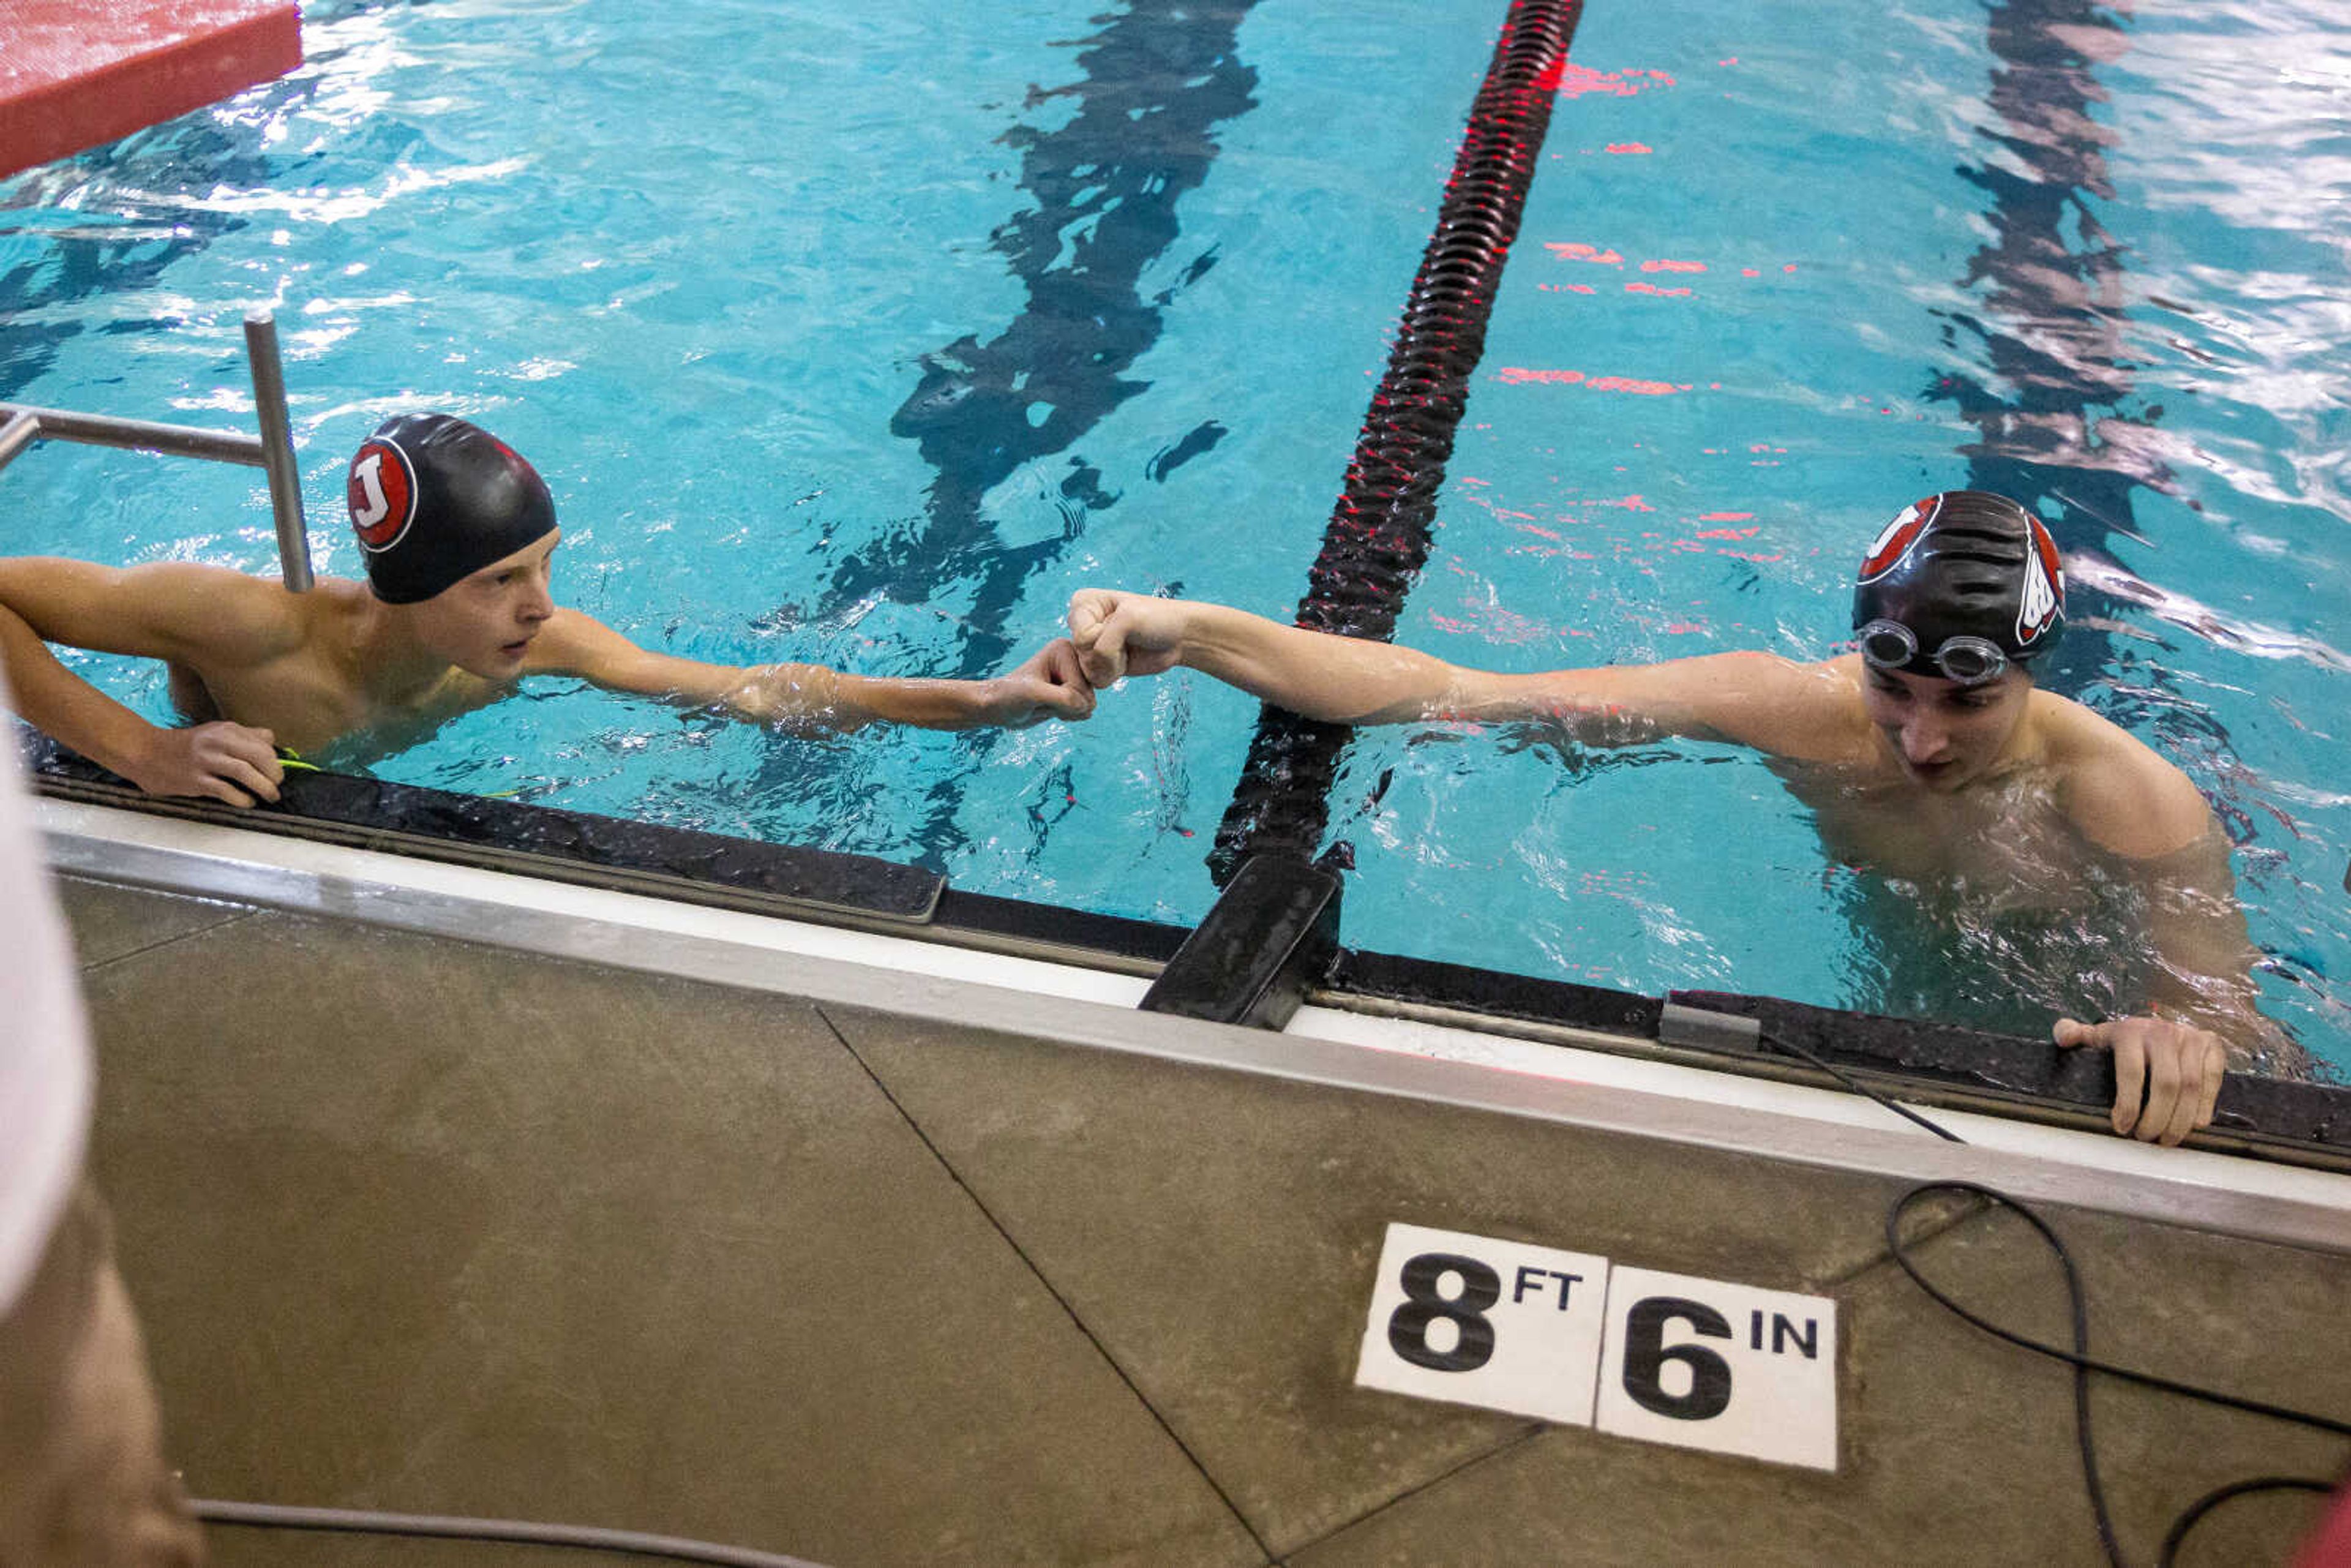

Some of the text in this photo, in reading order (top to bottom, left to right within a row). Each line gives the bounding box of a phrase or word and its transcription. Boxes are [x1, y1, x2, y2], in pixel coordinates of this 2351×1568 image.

[354, 453, 389, 529] J
[1388, 1253, 1817, 1421] 8 FT 6 IN
